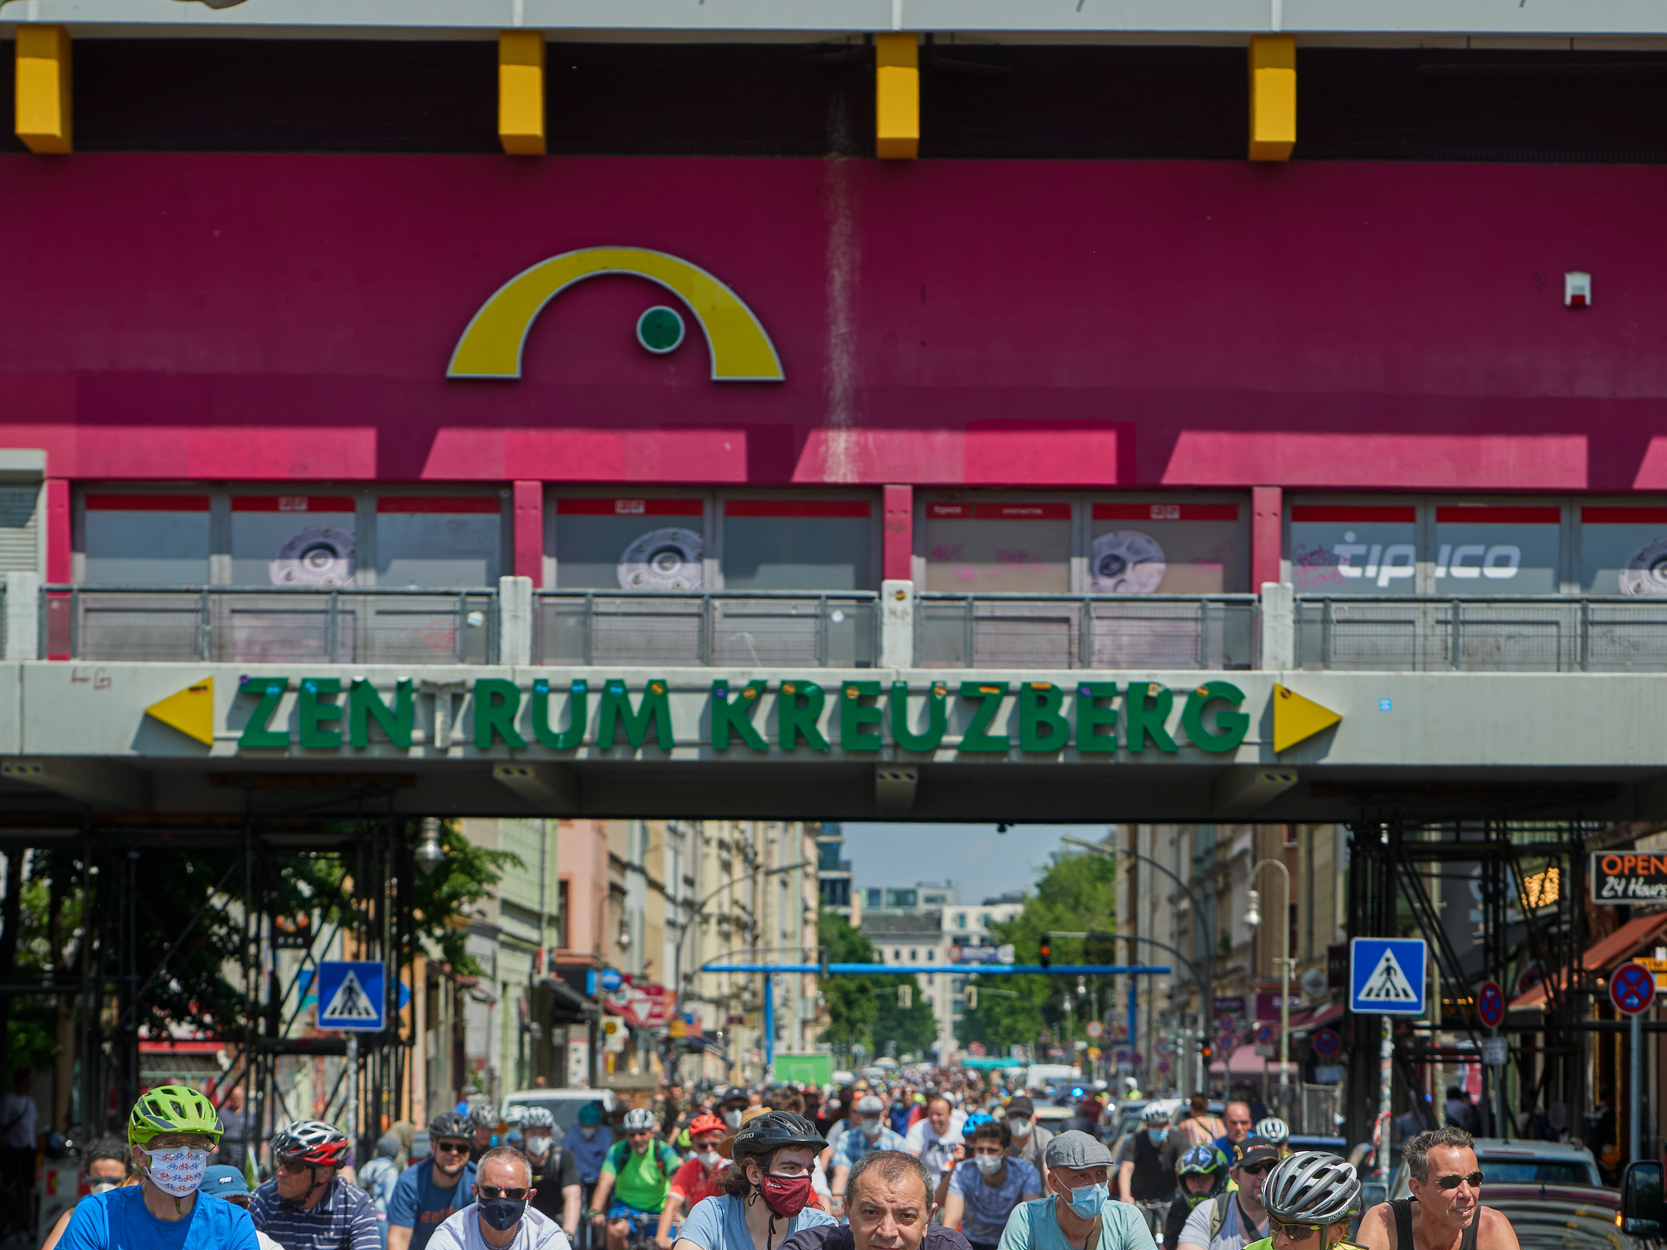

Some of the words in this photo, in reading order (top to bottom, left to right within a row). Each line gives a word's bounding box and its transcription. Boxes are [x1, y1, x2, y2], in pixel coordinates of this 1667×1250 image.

[238, 676, 675, 749] ZENTRUM
[711, 679, 1250, 753] KREUZBERG
[1601, 854, 1667, 875] OPEN
[1601, 876, 1626, 898] 24
